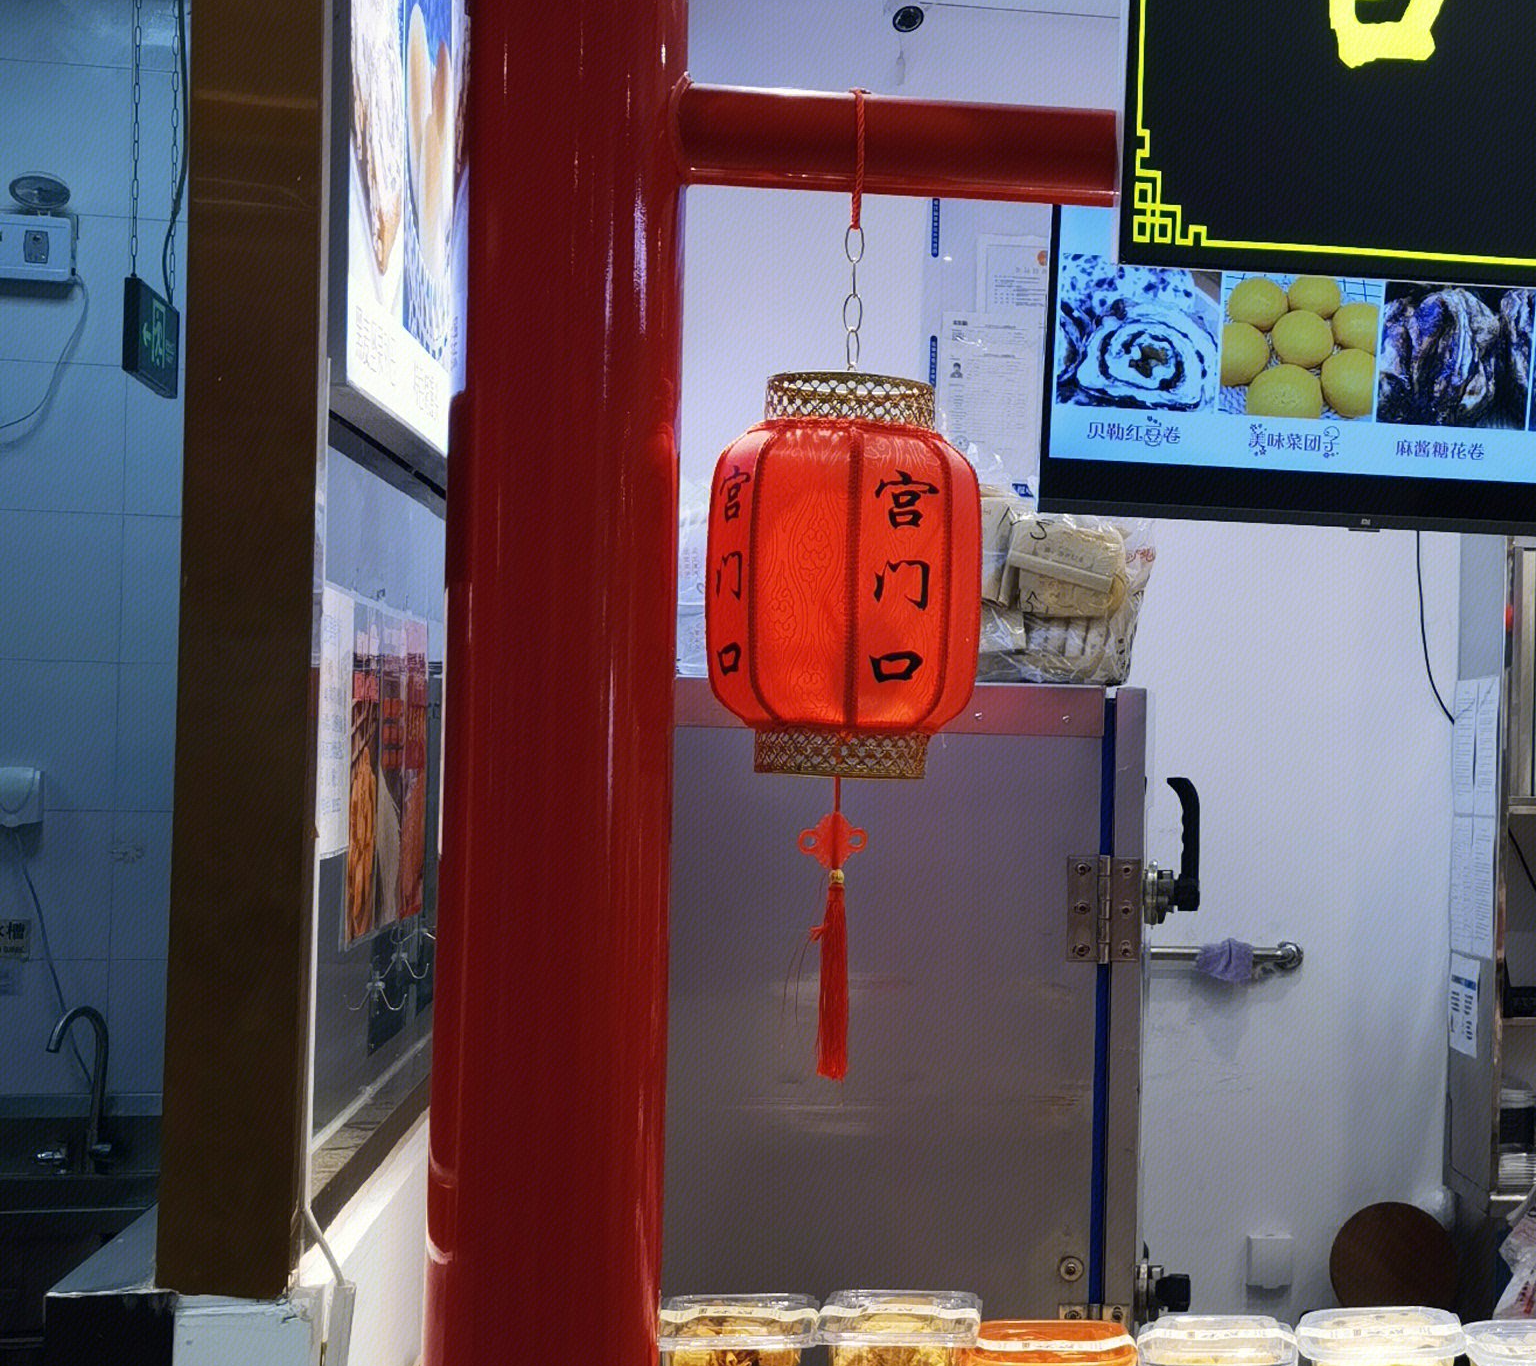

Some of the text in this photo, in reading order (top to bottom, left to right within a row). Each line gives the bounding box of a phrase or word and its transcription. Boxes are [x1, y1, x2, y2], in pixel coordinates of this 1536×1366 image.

[1087, 418, 1181, 446] 贝勒红豆卷
[1248, 425, 1341, 456] 美味菜团子
[1395, 438, 1485, 461] 麻酱糖花卷
[715, 464, 751, 677] 宫门口
[868, 468, 940, 685] 宫门口
